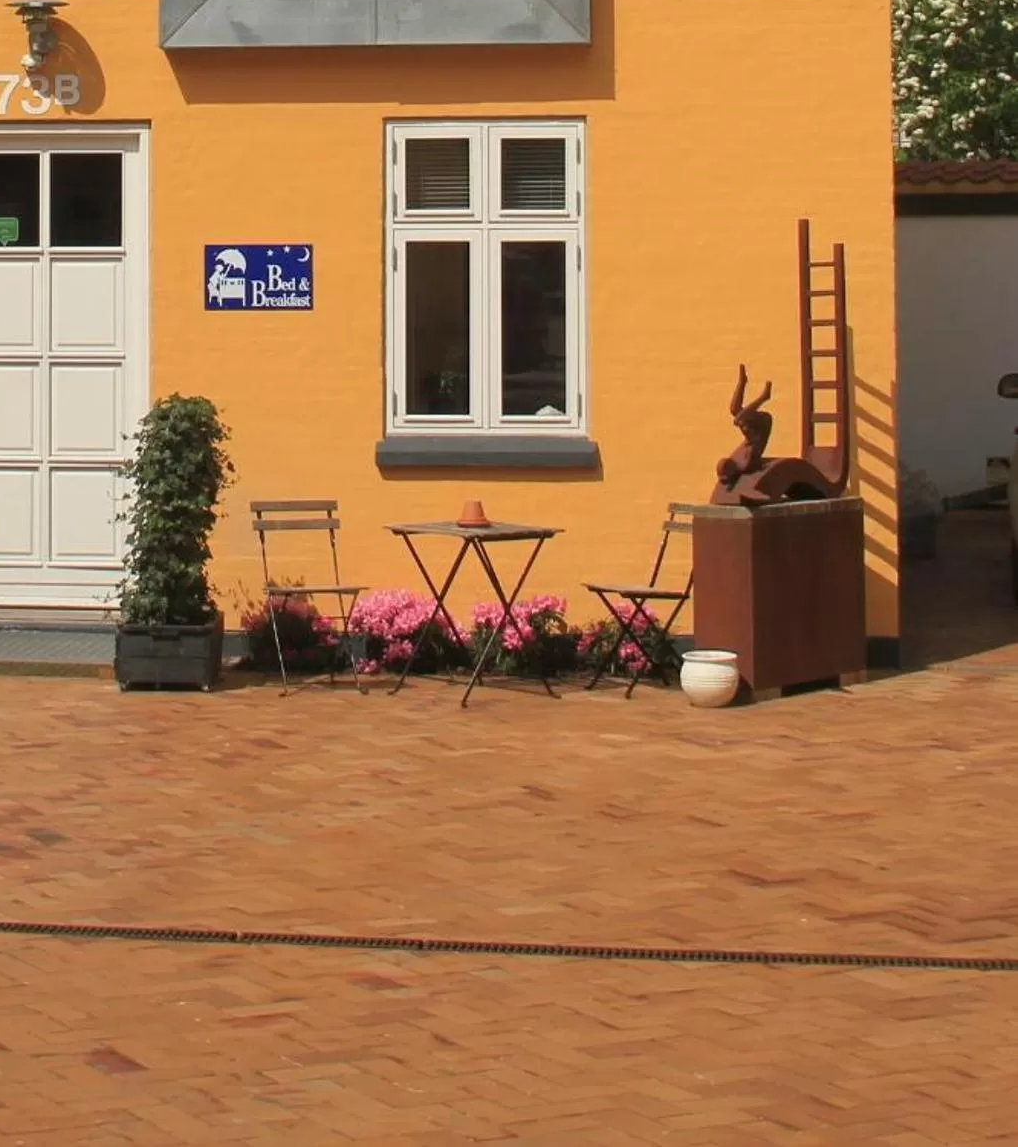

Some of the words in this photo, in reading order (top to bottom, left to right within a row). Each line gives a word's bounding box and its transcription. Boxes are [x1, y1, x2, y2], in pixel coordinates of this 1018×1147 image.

[267, 264, 296, 291] Bed
[298, 277, 310, 291] &
[251, 279, 311, 307] Breakfast
